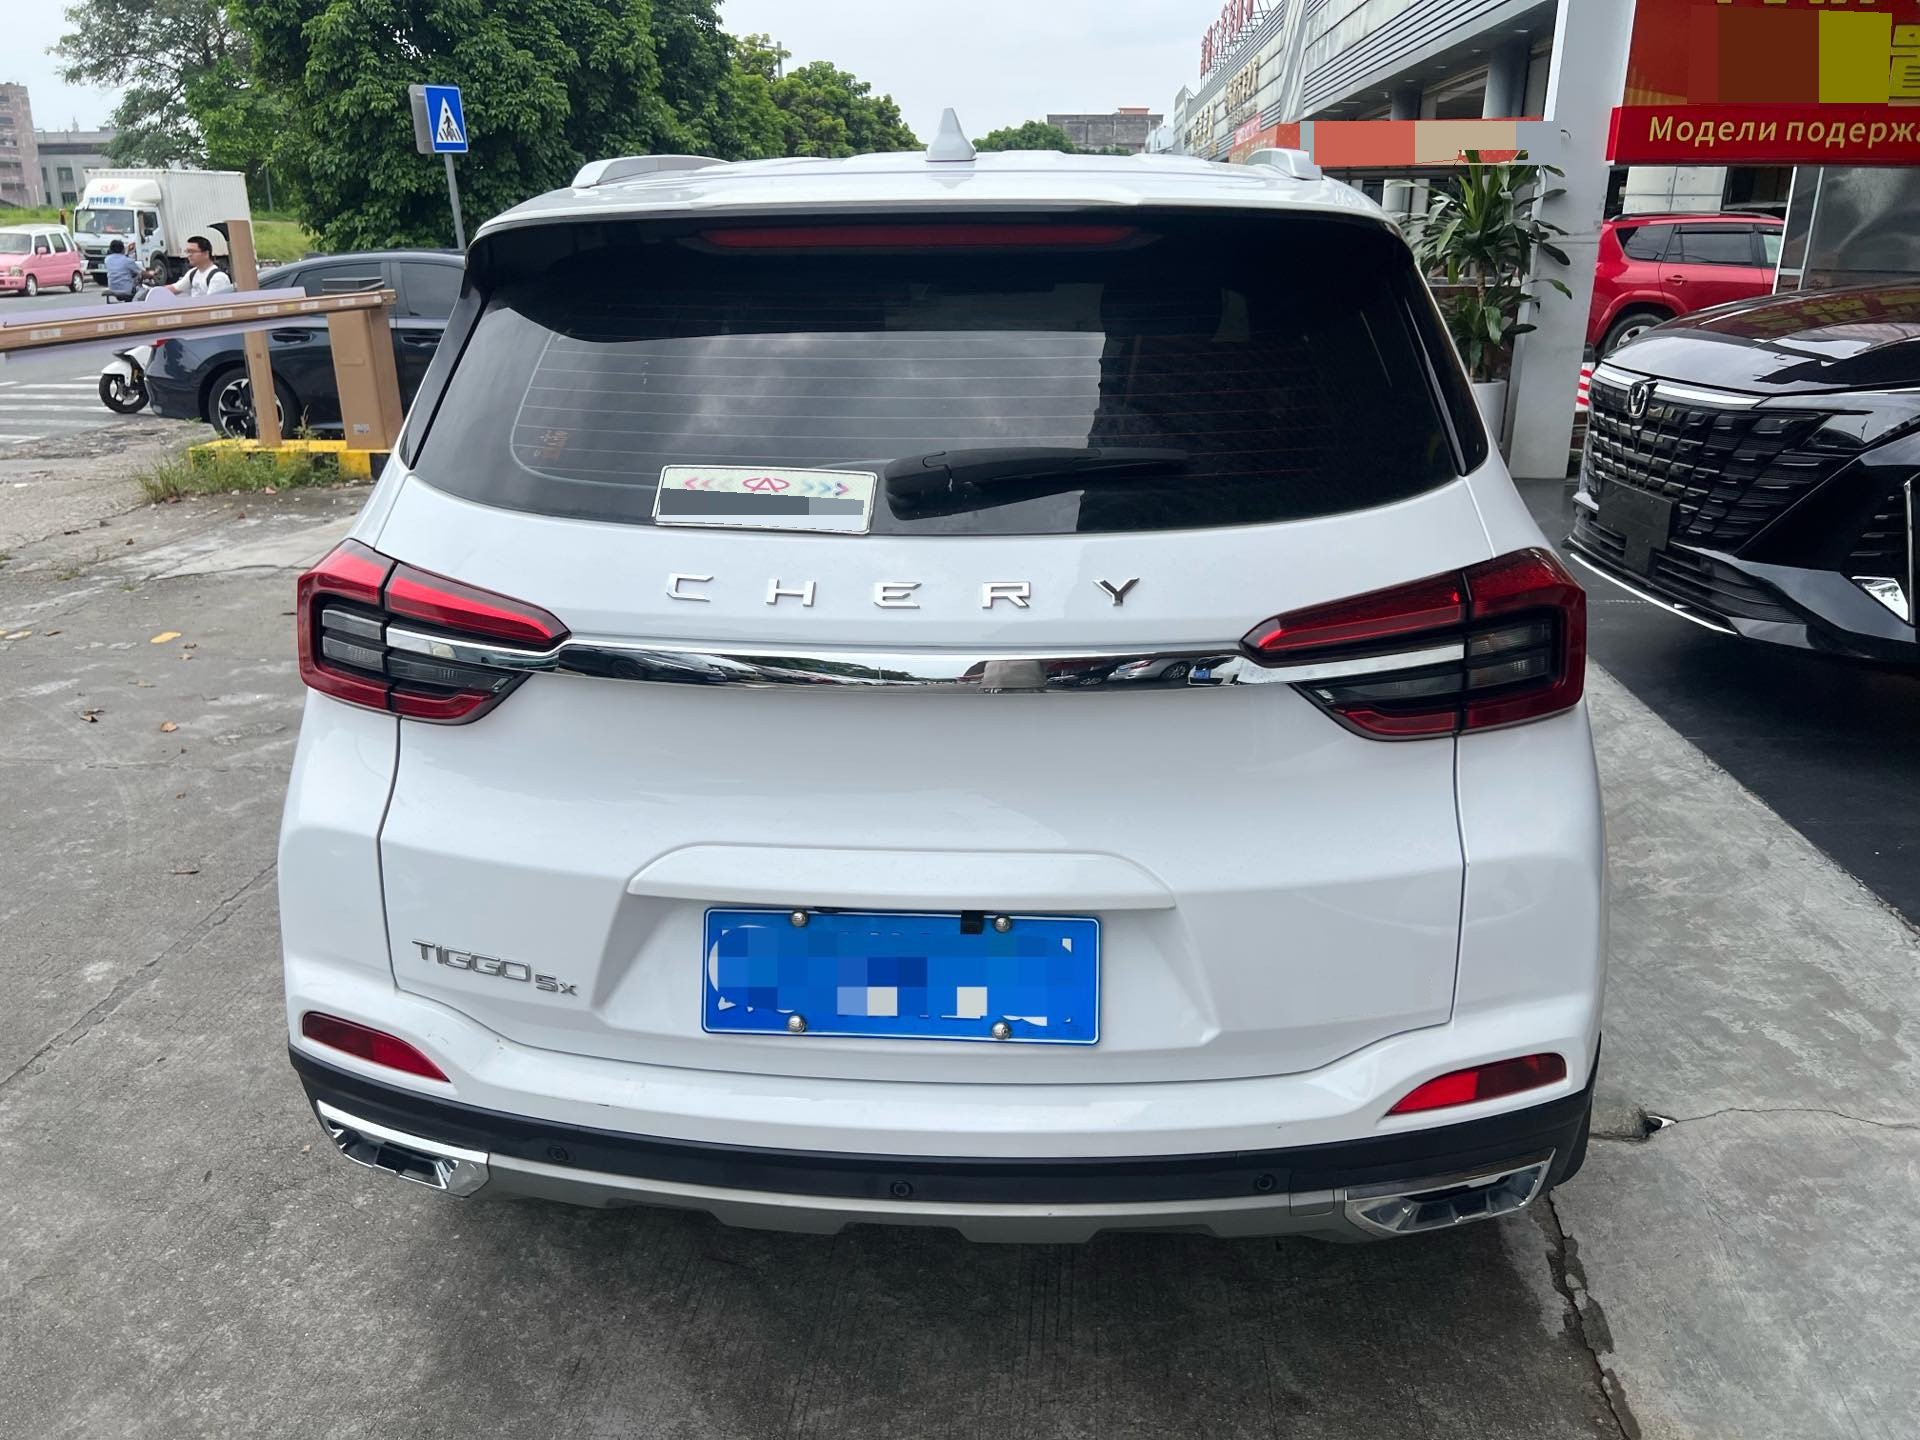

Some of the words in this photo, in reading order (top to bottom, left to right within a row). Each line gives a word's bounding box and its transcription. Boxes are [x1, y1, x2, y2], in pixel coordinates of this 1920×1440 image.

[1649, 116, 1777, 147] Модели
[666, 573, 1140, 609] CHERY
[412, 939, 531, 983] TIGGO
